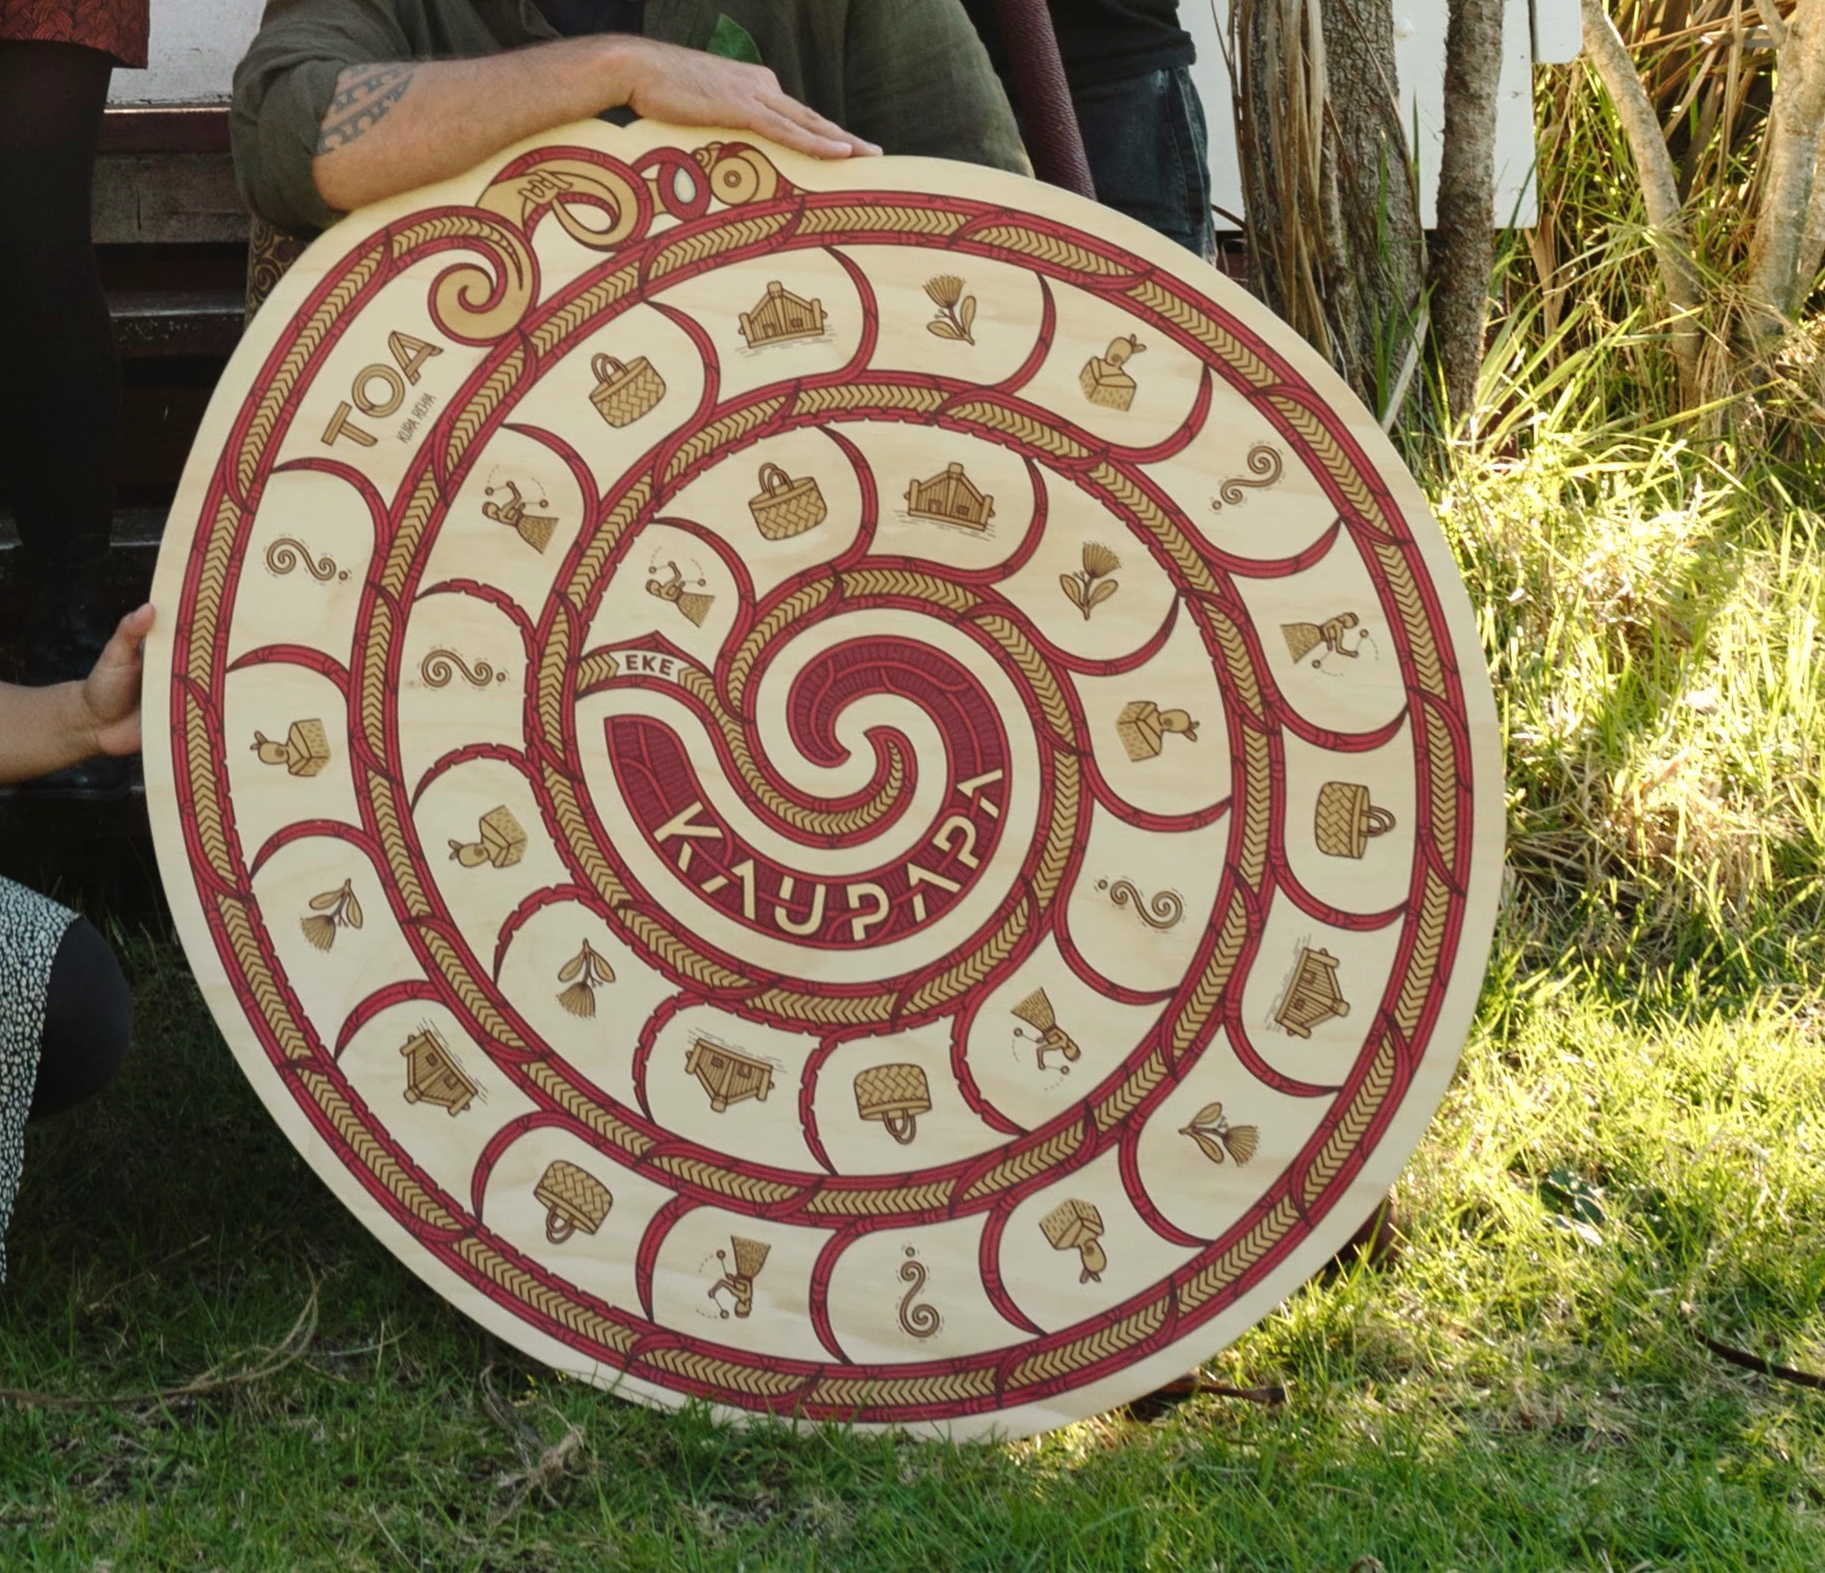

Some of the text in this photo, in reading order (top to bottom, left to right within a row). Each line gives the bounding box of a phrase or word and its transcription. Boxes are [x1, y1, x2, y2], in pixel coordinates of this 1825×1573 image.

[320, 330, 445, 448] TOA
[625, 654, 675, 677] EKE
[654, 768, 1004, 942] KAUPAPA
